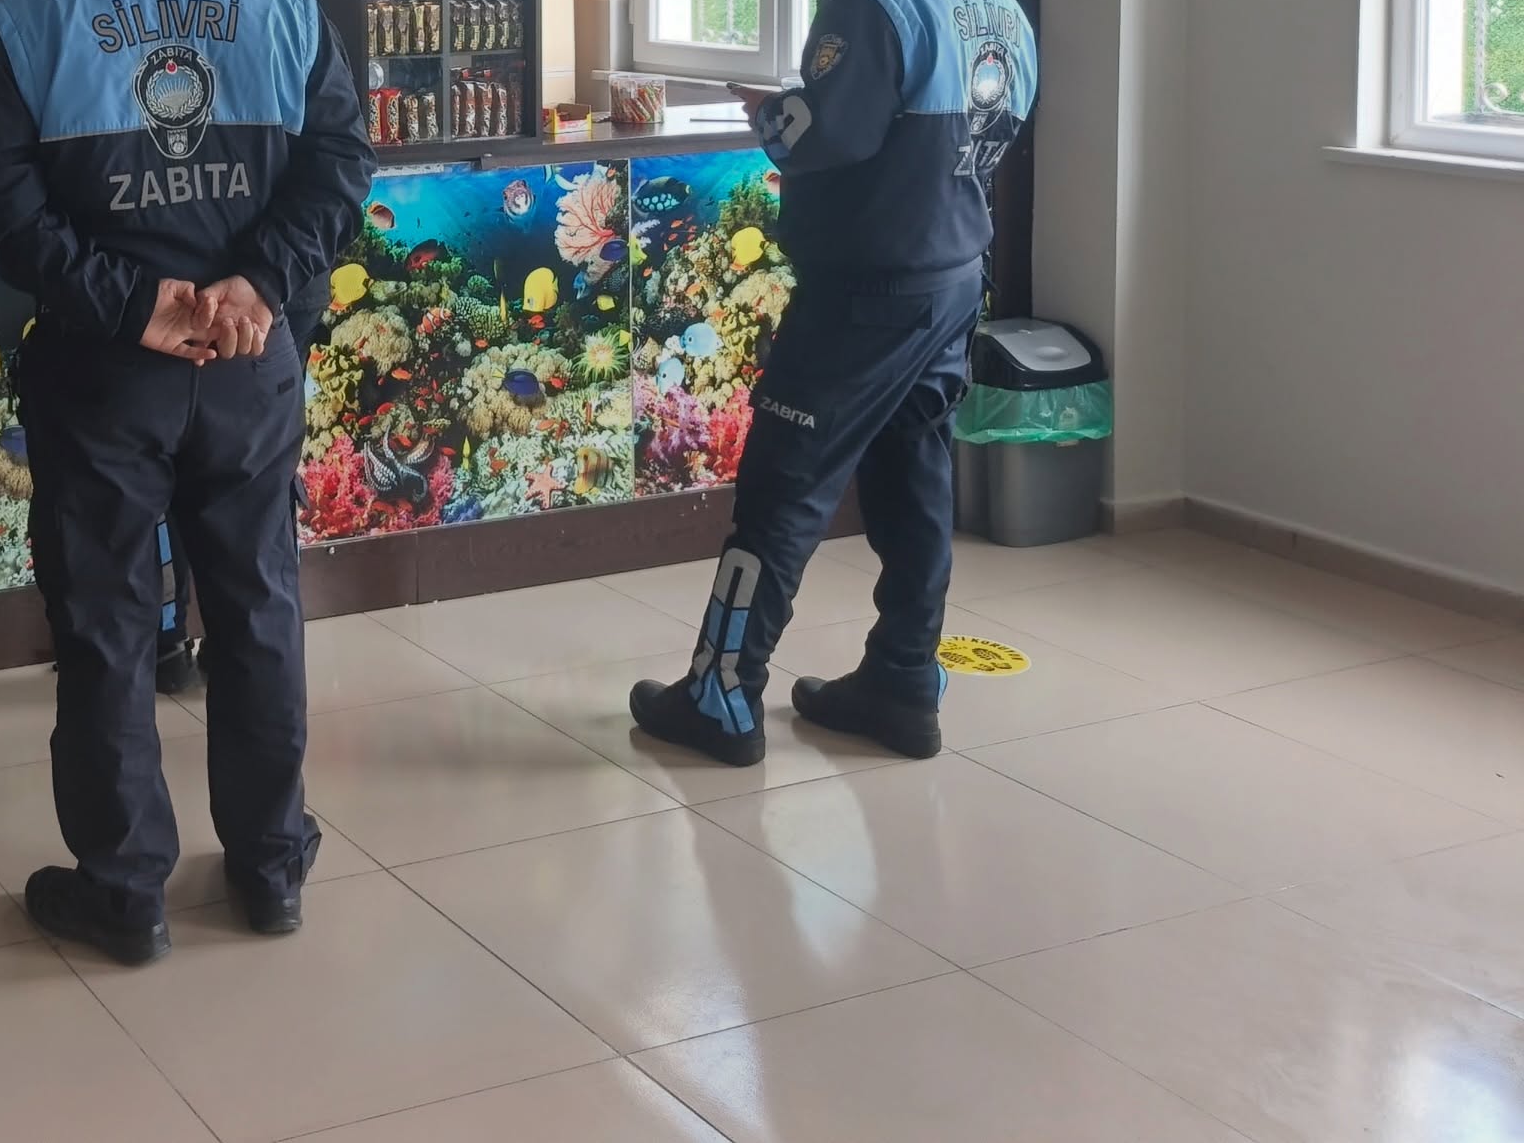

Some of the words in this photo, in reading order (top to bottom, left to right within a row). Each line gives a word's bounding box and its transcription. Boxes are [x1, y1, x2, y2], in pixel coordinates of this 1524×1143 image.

[150, 47, 193, 65] ZABITA
[108, 162, 252, 211] ZABITA
[758, 396, 817, 430] ZABITA
